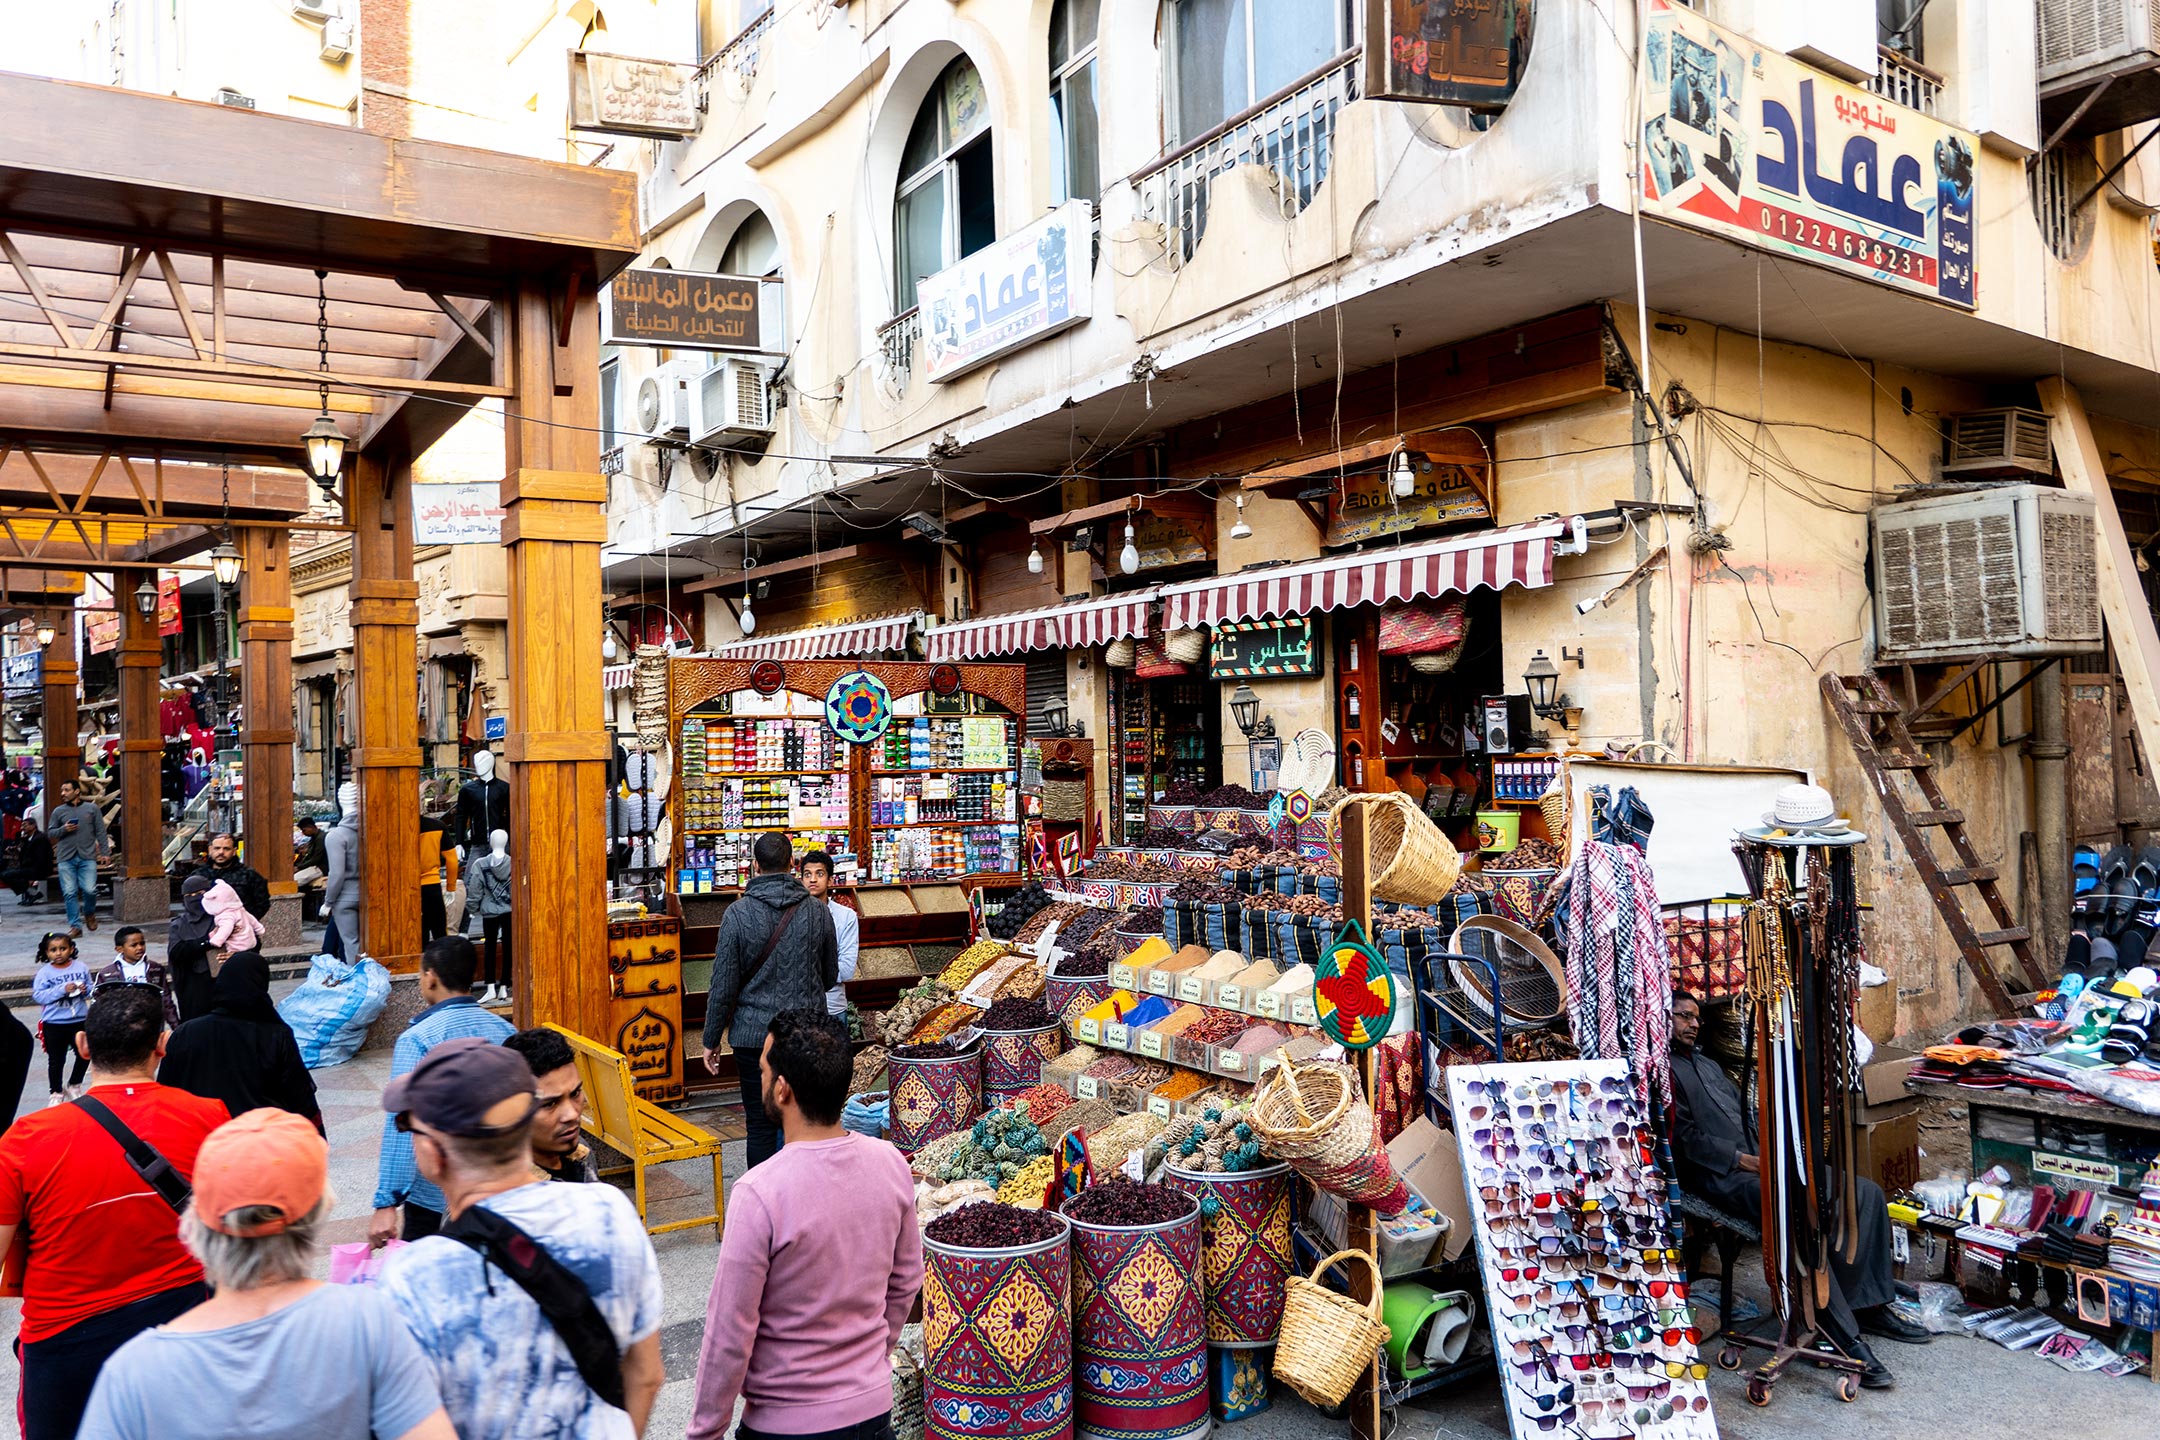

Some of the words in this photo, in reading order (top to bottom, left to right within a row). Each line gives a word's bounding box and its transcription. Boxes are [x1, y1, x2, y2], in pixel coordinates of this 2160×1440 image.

[1834, 95, 1896, 135] ستوديو
[1757, 79, 1925, 239] عماد
[1761, 207, 1925, 279] 01224688231
[1942, 231, 1969, 256] صورتك
[694, 281, 754, 313] معمل
[965, 263, 1040, 335] عماد
[625, 312, 679, 336] الطبية
[683, 317, 745, 339] للتحاليل
[1250, 629, 1306, 668] عباس
[1115, 976, 1130, 985] Curry
[1220, 996, 1239, 1005] Cumin
[628, 1042, 666, 1056] محمود
